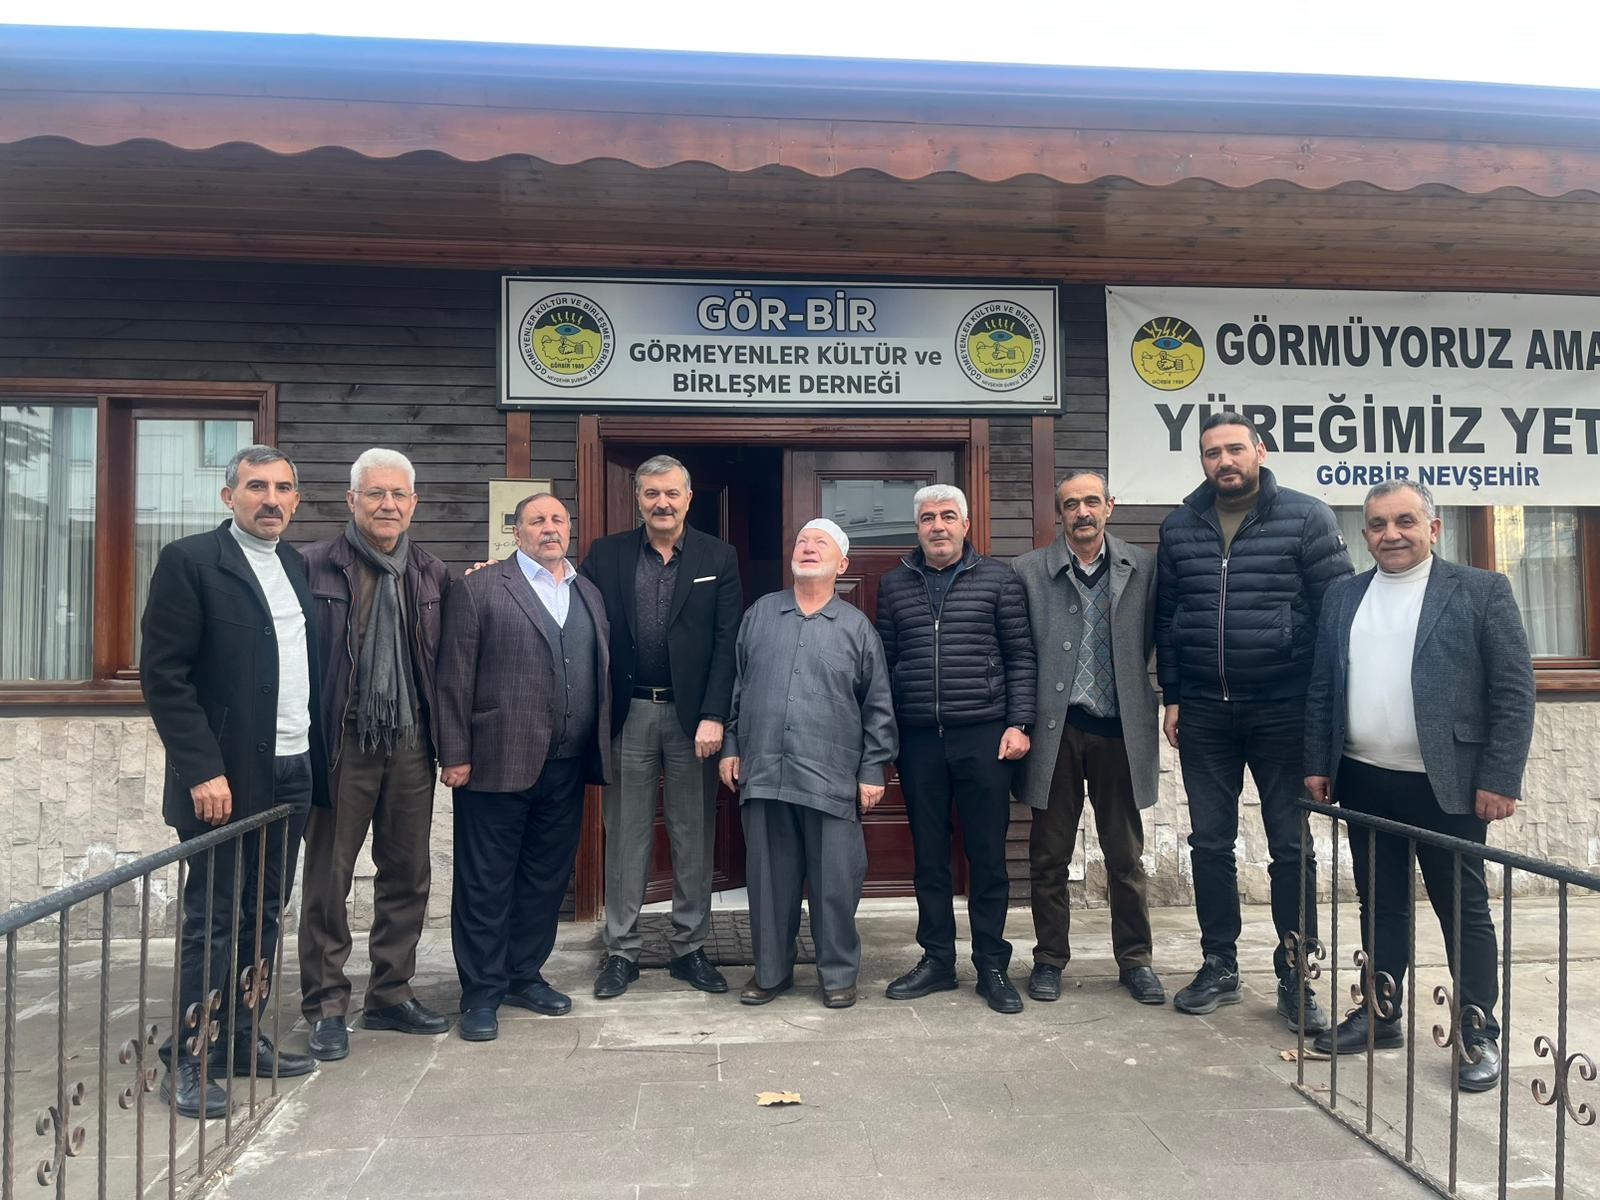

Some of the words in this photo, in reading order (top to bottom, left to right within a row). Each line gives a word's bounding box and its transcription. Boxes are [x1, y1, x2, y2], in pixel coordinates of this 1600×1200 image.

[696, 289, 876, 333] GÖR-BİR
[970, 304, 1001, 322] KÜLTÜR
[1003, 305, 1014, 314] VE
[523, 315, 547, 375] GÖRMEYENLER
[535, 296, 568, 316] KÜLTÜR
[571, 297, 582, 307] VE
[1216, 315, 1513, 369] GÖRMÜYORUZ
[629, 340, 809, 366] GÖRMEYENLER
[818, 342, 908, 366] KÜLTÜR
[914, 350, 942, 366] ve
[673, 370, 790, 398] BİRLEŞME
[799, 368, 901, 394] DERNEĞİ
[1317, 462, 1409, 485] GÖRBİR
[1419, 462, 1540, 491] NEVŞEHİR
